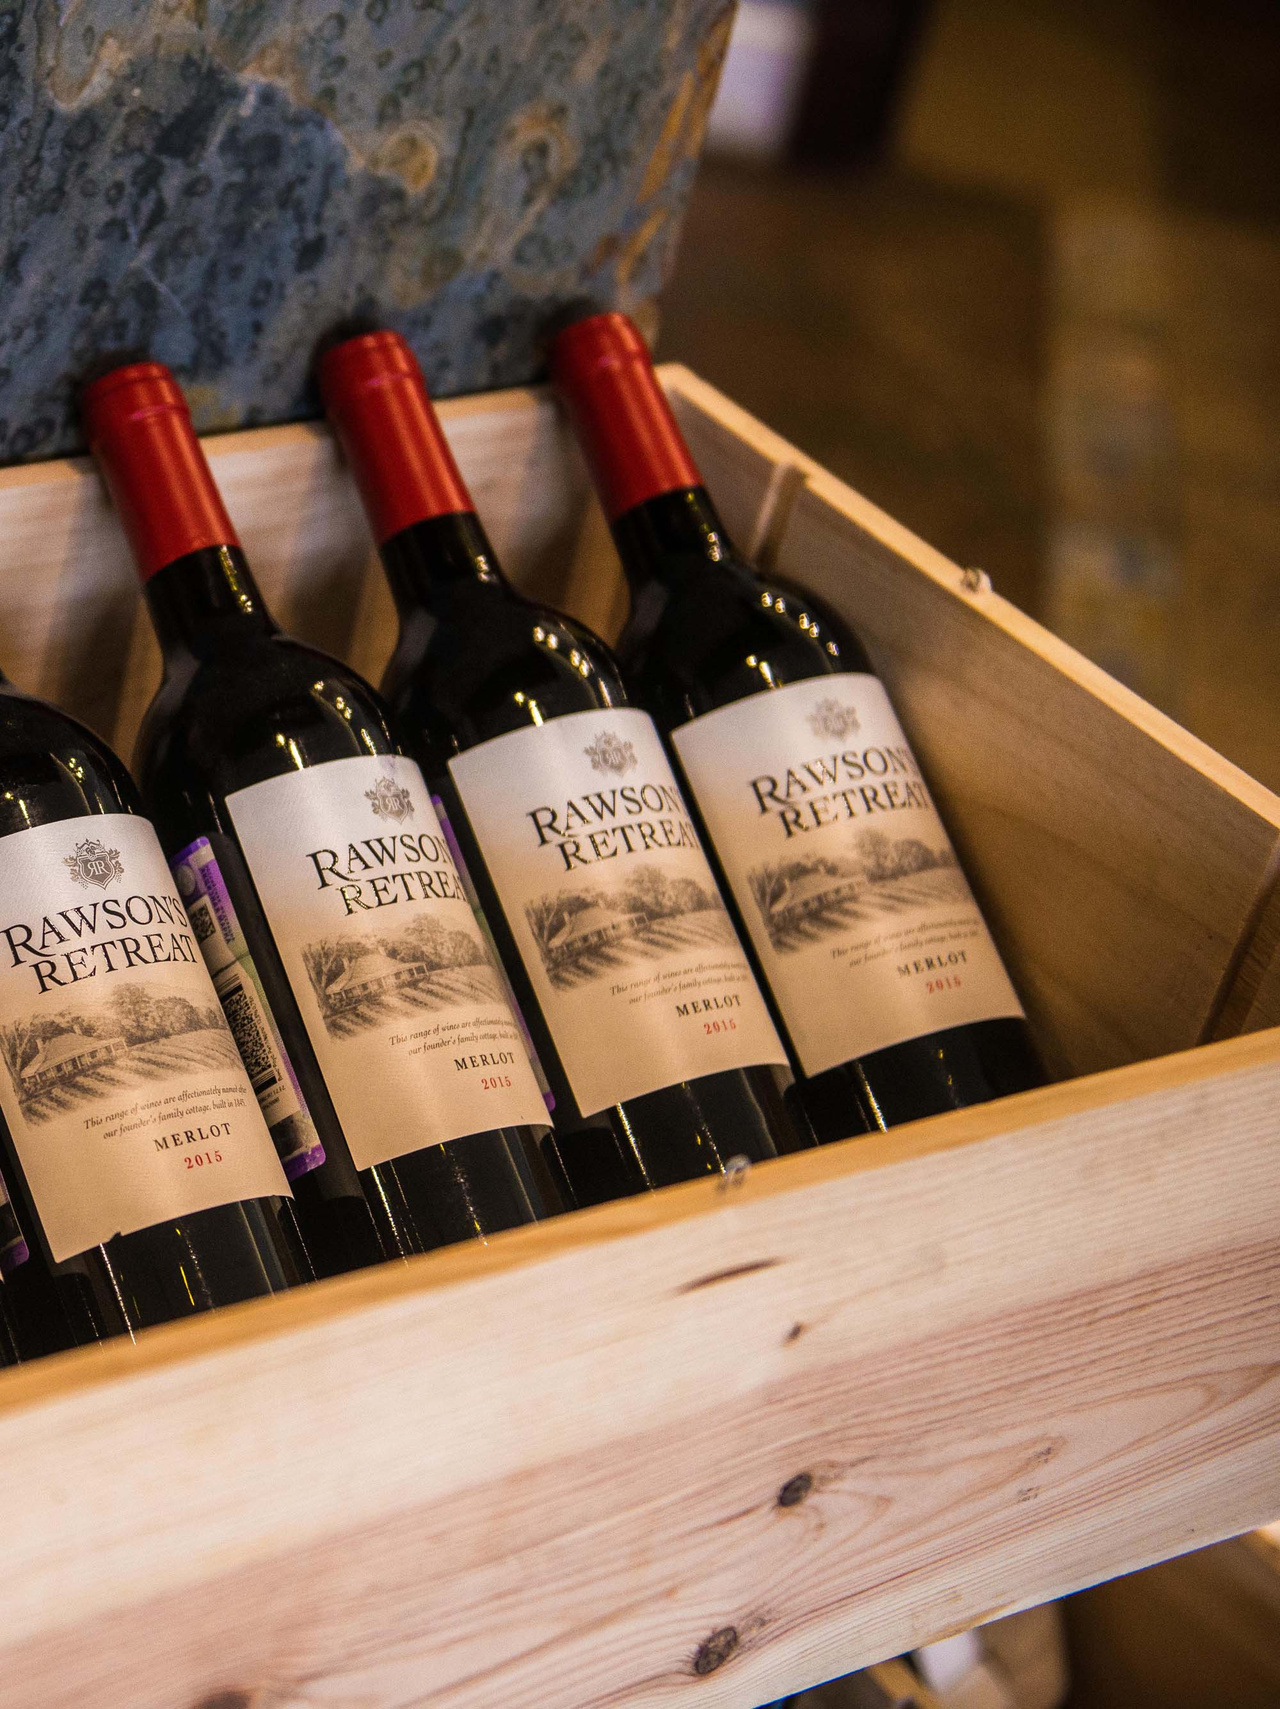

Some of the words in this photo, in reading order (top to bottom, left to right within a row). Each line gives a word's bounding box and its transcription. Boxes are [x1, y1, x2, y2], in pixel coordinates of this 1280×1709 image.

[750, 746, 915, 815] RAWSON
[526, 784, 686, 847] RAWSON
[779, 779, 929, 839] RETREAT
[306, 833, 453, 890] RAWSON
[336, 870, 467, 916] RETREA
[28, 932, 199, 995] RETREAT
[896, 950, 968, 978] MERLOT
[925, 975, 962, 994] 2015
[675, 994, 742, 1017] MERLOT
[389, 1035, 408, 1046] This
[410, 1028, 431, 1040] range
[432, 1024, 440, 1035] of
[441, 1022, 460, 1032] wines
[461, 1021, 471, 1029] are
[704, 1018, 737, 1035] 2015
[408, 1046, 422, 1056] our
[423, 1036, 456, 1055] founder's
[457, 1032, 478, 1045] family
[453, 1051, 516, 1072] MERLOT
[481, 1075, 512, 1090] 2015
[84, 1116, 103, 1130] This
[105, 1108, 128, 1121] range
[130, 1102, 139, 1115] of
[140, 1099, 162, 1110] wines
[164, 1095, 176, 1105] are
[177, 1085, 221, 1102] affectionately
[103, 1128, 118, 1139] our
[119, 1115, 156, 1136] founder's
[158, 1107, 184, 1124] family
[153, 1122, 232, 1152] MERLOT
[184, 1150, 223, 1169] 2015
